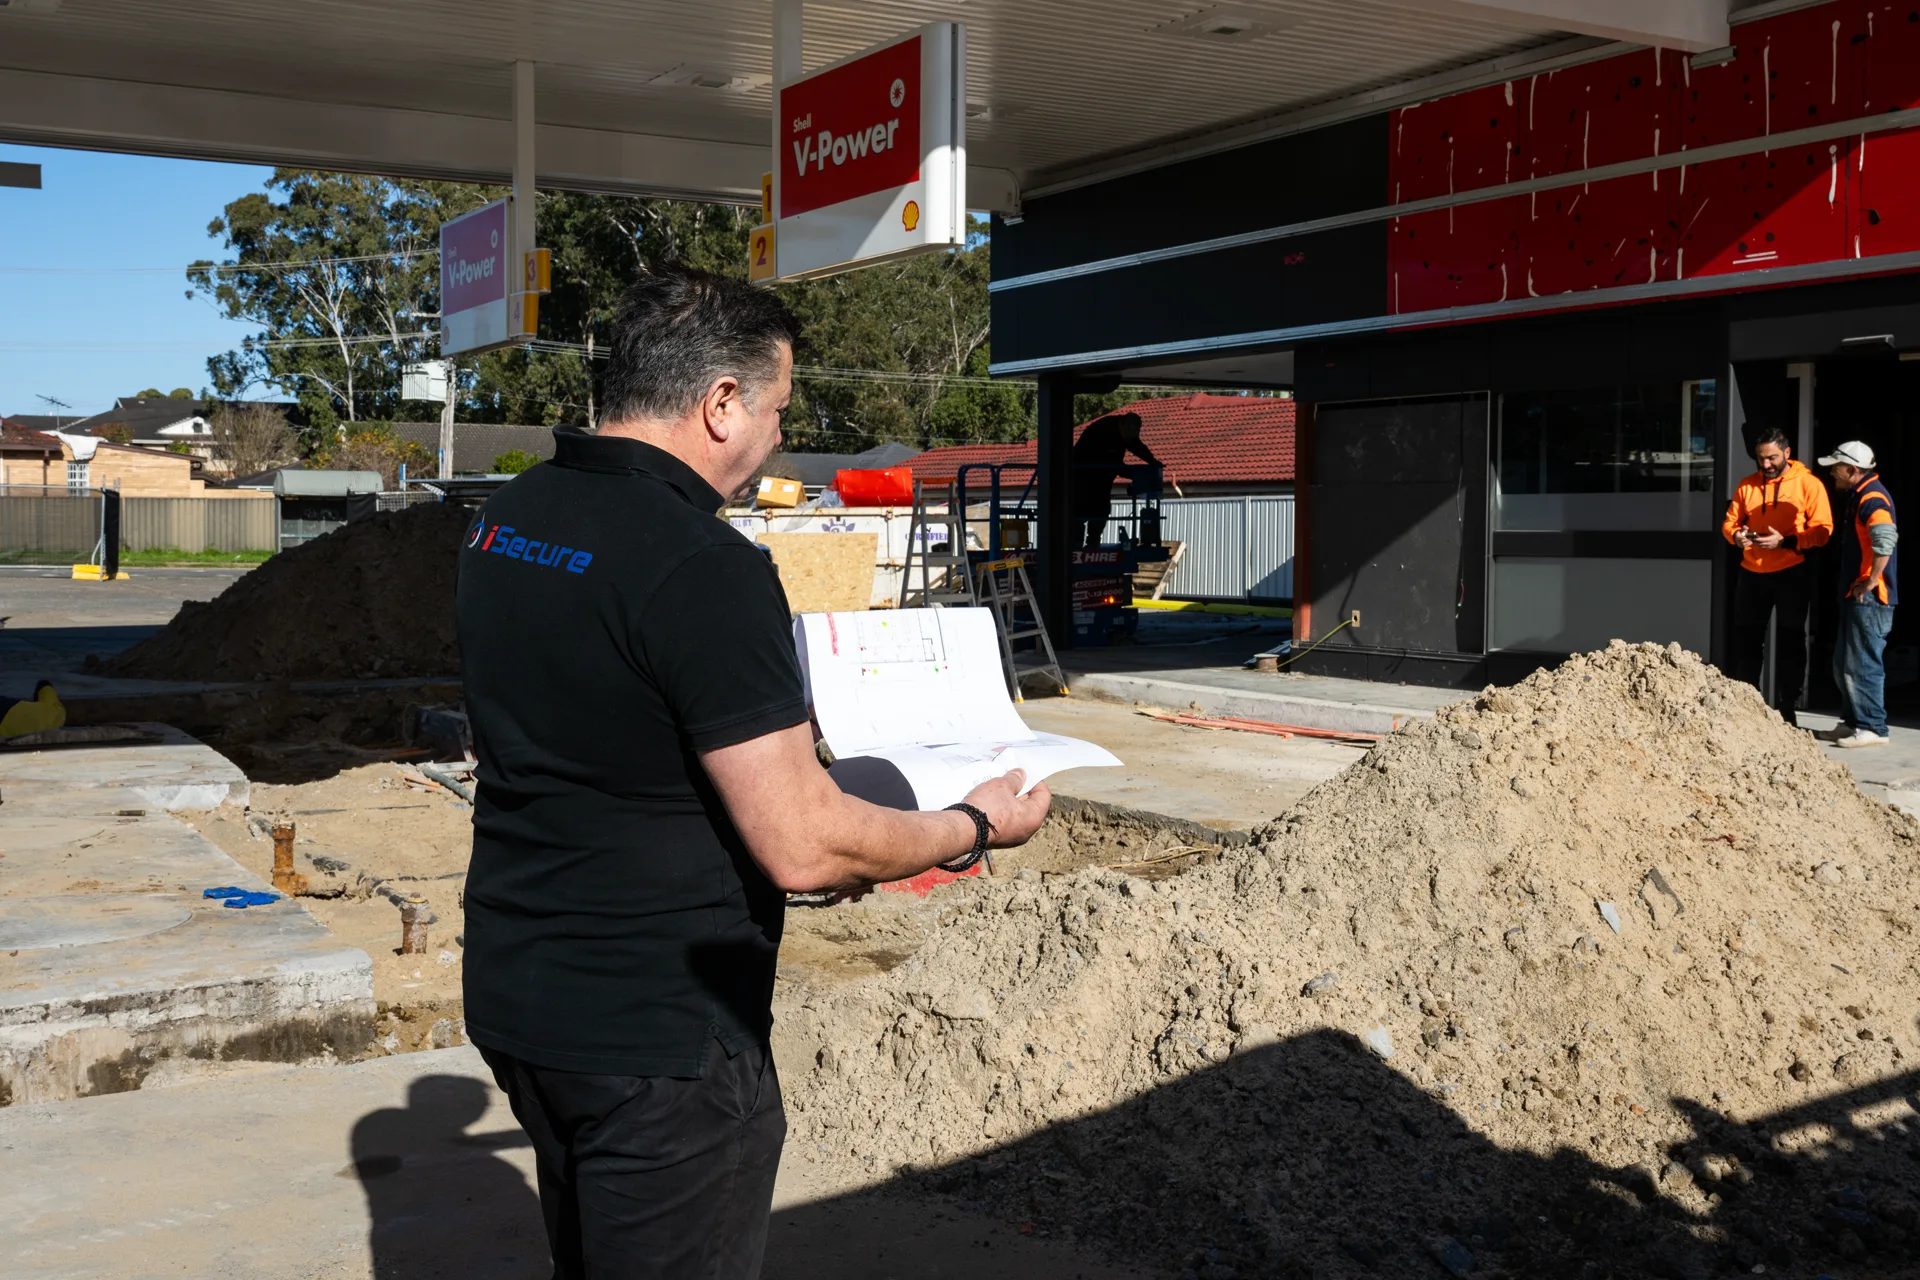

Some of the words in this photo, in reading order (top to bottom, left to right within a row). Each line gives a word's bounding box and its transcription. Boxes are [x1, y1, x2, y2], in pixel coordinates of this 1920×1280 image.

[793, 113, 811, 133] Shell
[793, 117, 899, 177] V-Power
[756, 236, 766, 266] 2
[448, 256, 496, 288] V-Power
[528, 259, 535, 281] 3
[513, 302, 520, 322] 4
[482, 525, 593, 574] iSecure
[1084, 552, 1118, 562] HIRE
